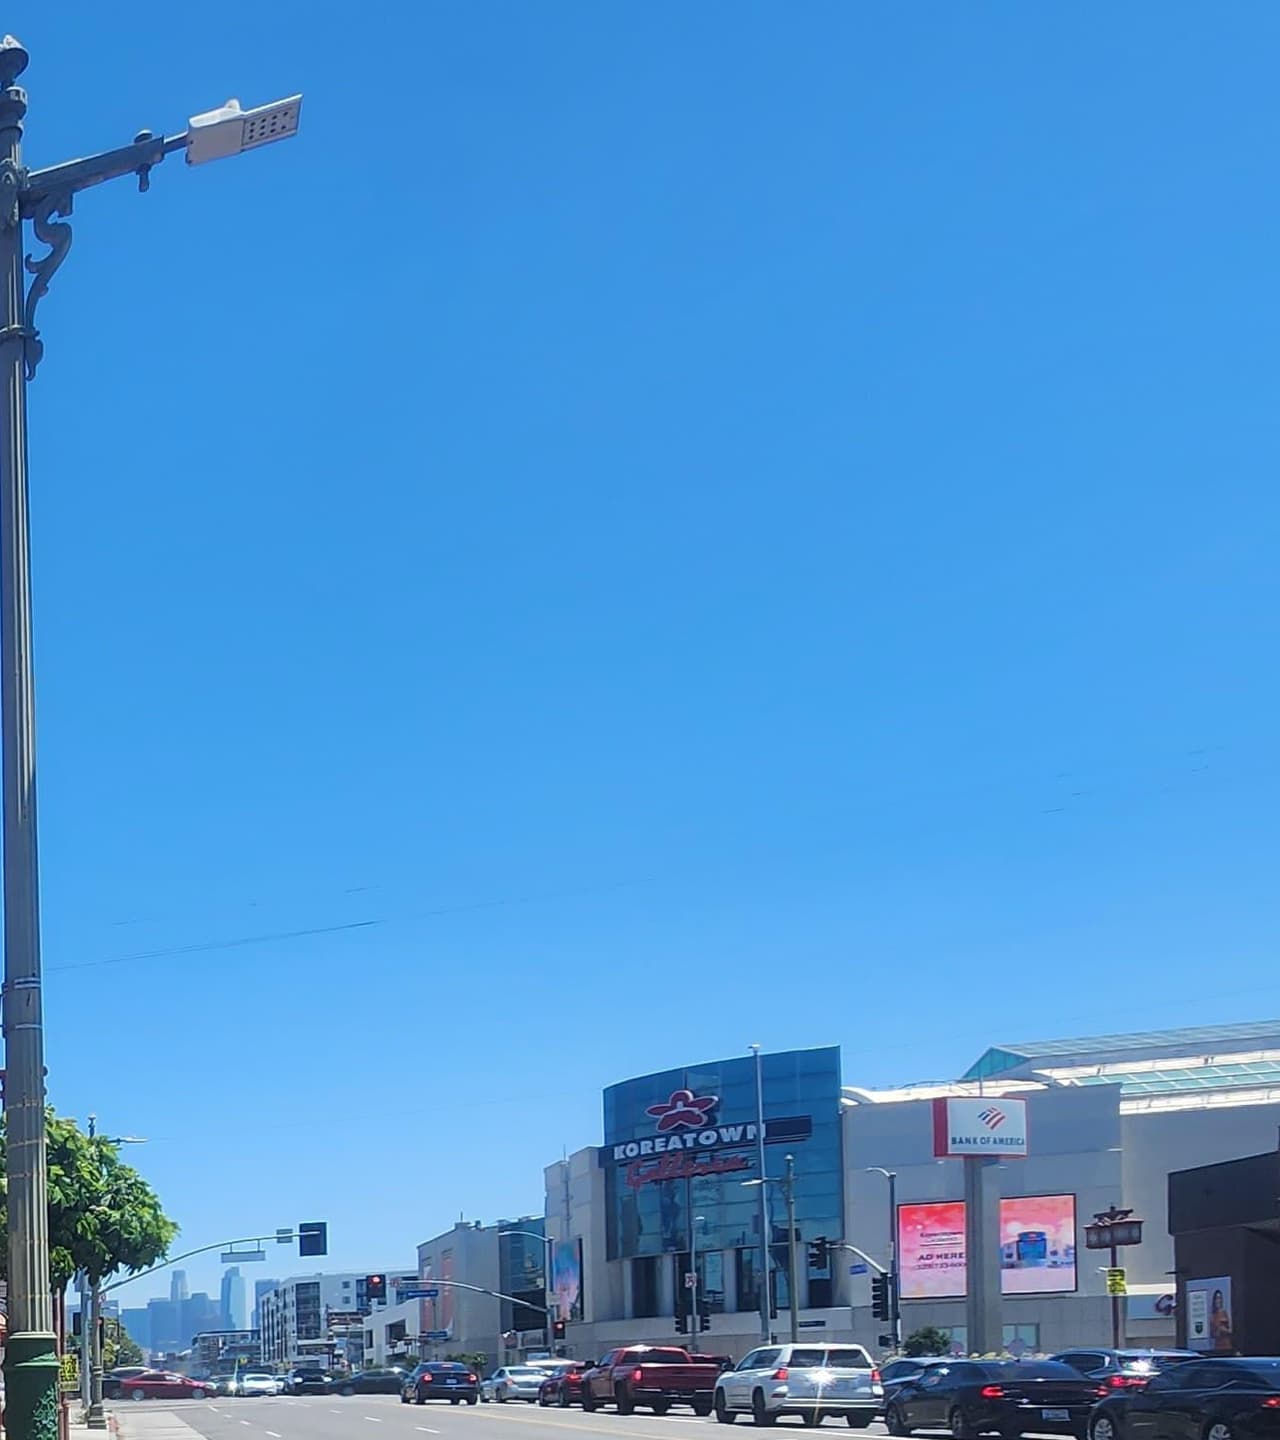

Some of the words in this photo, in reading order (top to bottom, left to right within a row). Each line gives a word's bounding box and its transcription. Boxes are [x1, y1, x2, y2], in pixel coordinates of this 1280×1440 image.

[613, 1122, 766, 1161] KOREATOWN
[951, 1136, 978, 1145] BANK
[979, 1136, 992, 1145] OF
[993, 1136, 1025, 1146] AMERICA
